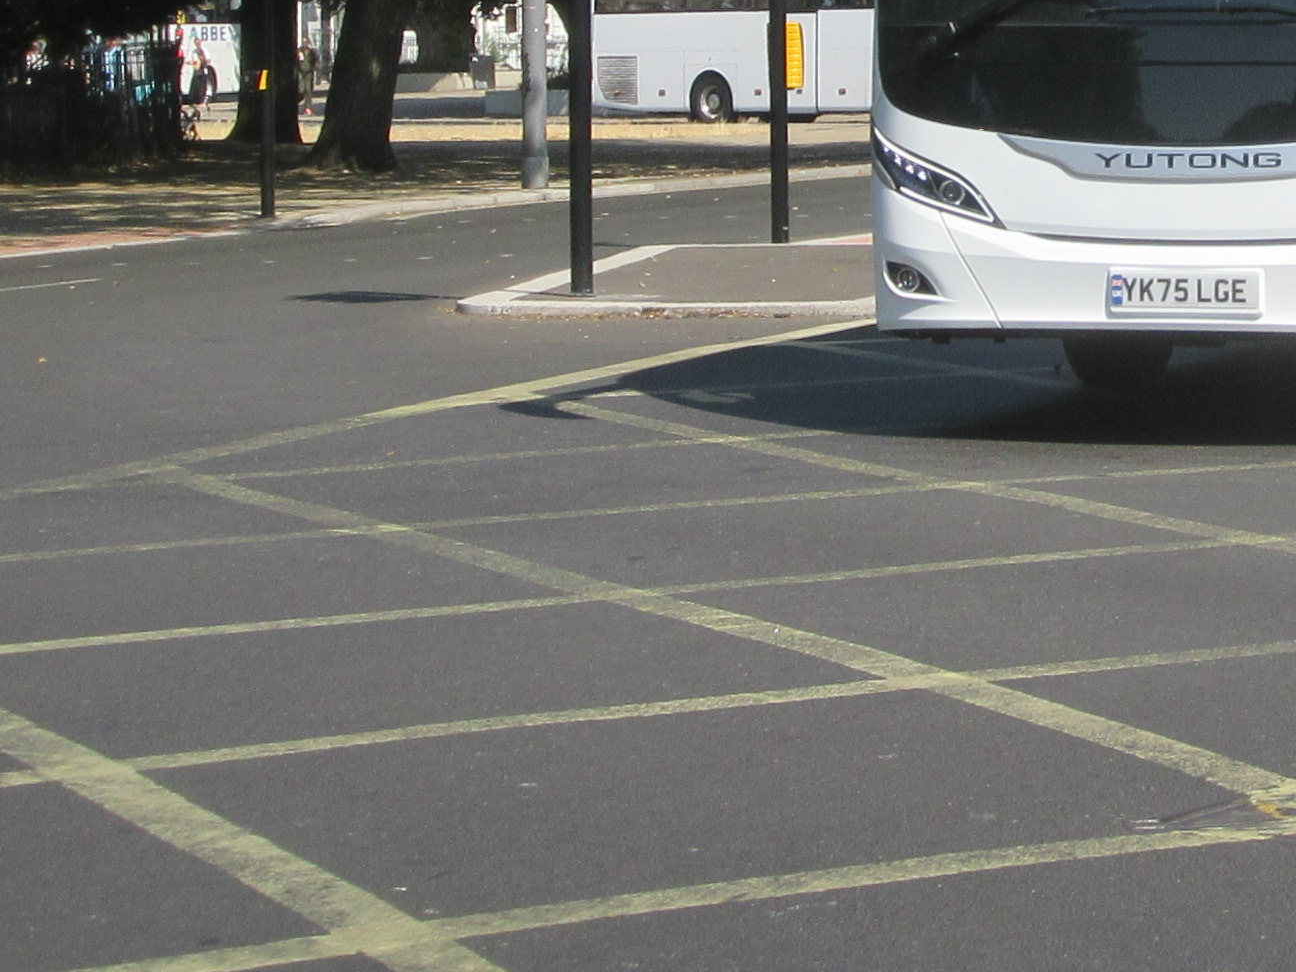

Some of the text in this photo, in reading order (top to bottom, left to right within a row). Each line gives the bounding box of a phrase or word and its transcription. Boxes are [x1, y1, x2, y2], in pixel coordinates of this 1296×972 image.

[1094, 152, 1283, 169] YUTONG
[1122, 277, 1247, 303] YK75 LGE
